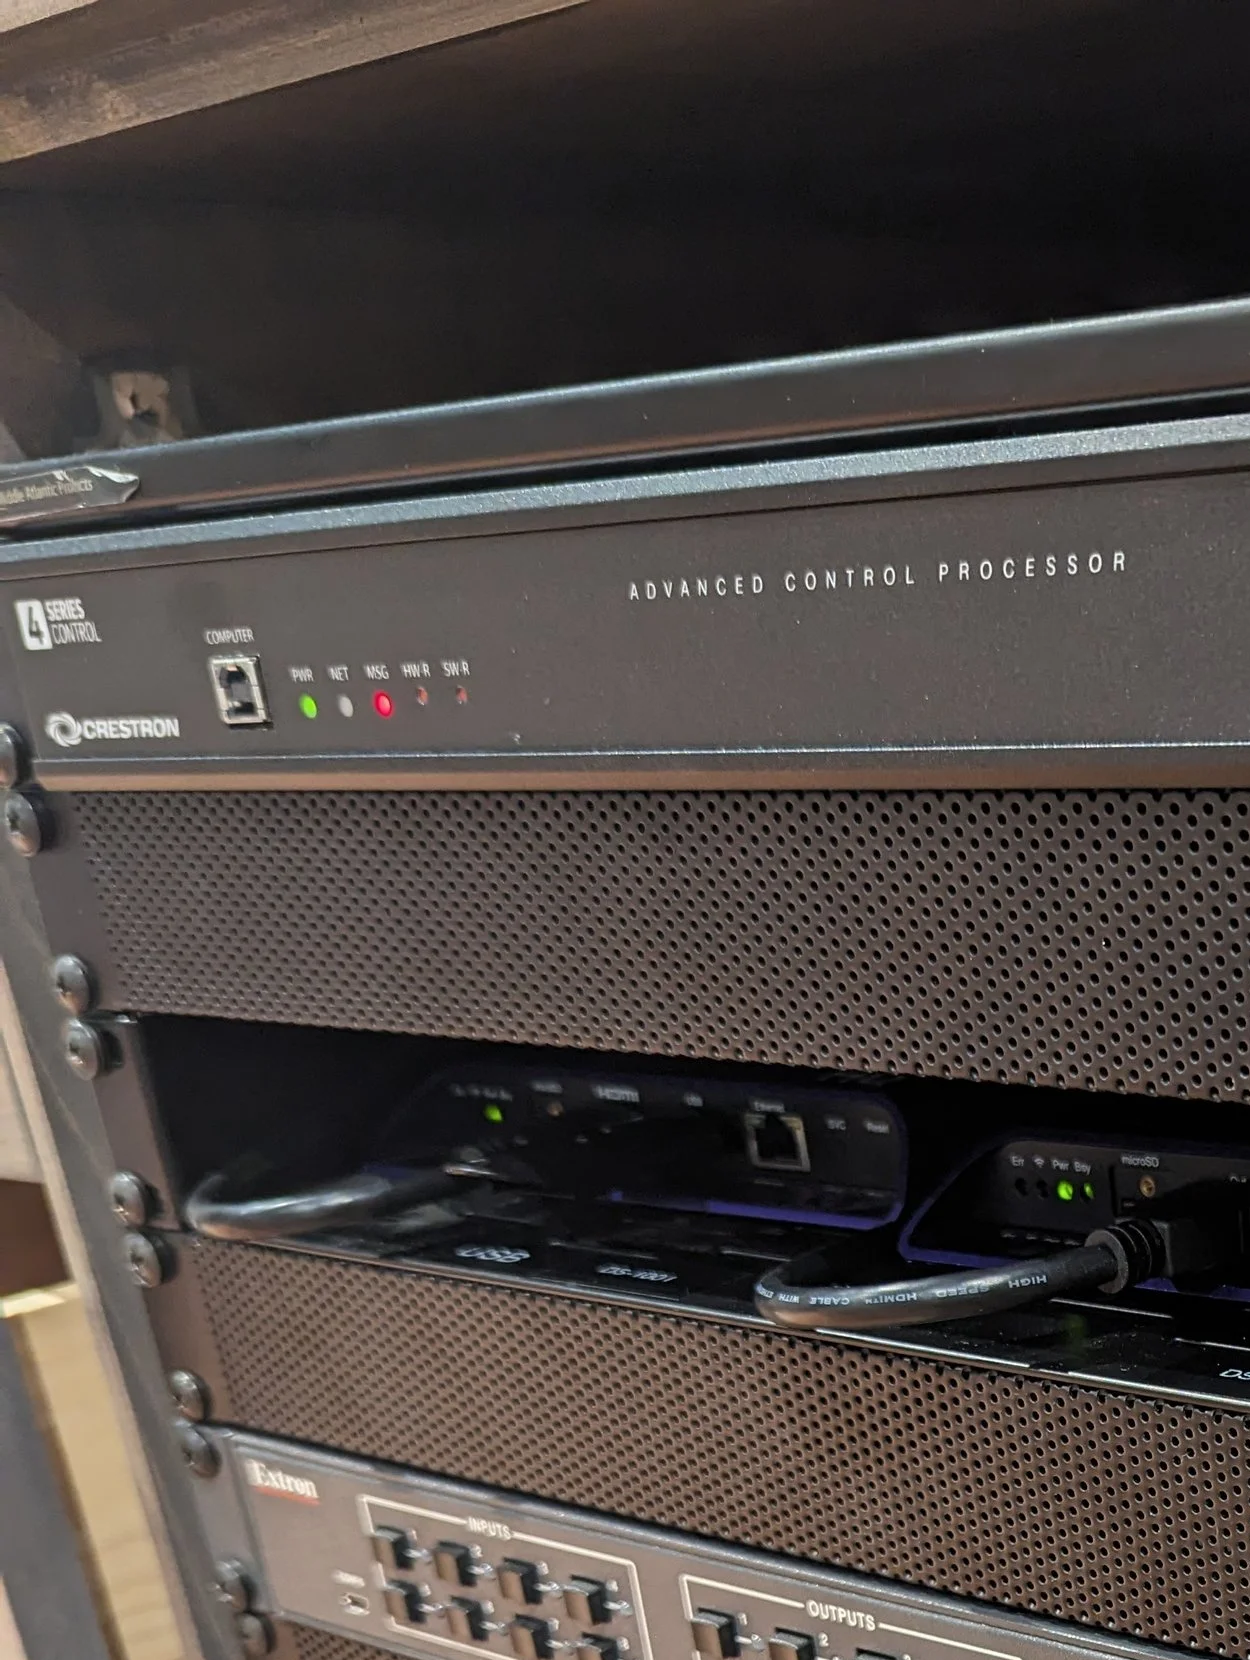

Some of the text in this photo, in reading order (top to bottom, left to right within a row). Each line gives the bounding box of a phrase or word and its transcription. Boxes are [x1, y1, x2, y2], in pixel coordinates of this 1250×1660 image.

[629, 550, 1128, 601] ADVANCED CONTROL PROCESSOR
[44, 599, 85, 621] SERIES
[50, 621, 102, 643] CONTROL
[205, 629, 254, 645] COMPUTER
[289, 665, 314, 682] PWR
[328, 664, 349, 681] NET
[364, 662, 389, 680] MSG
[81, 717, 181, 739] CRESTRON
[1121, 1155, 1159, 1168] microSD
[455, 1246, 531, 1263] USB
[935, 1284, 990, 1298] SPEED
[1008, 1274, 1047, 1289] HIGH
[779, 1293, 799, 1304] WITH
[808, 1296, 850, 1306] CABLE
[246, 1460, 319, 1499] Extron
[466, 1516, 512, 1542] INPUTS
[806, 1600, 876, 1631] OUTPUTS
